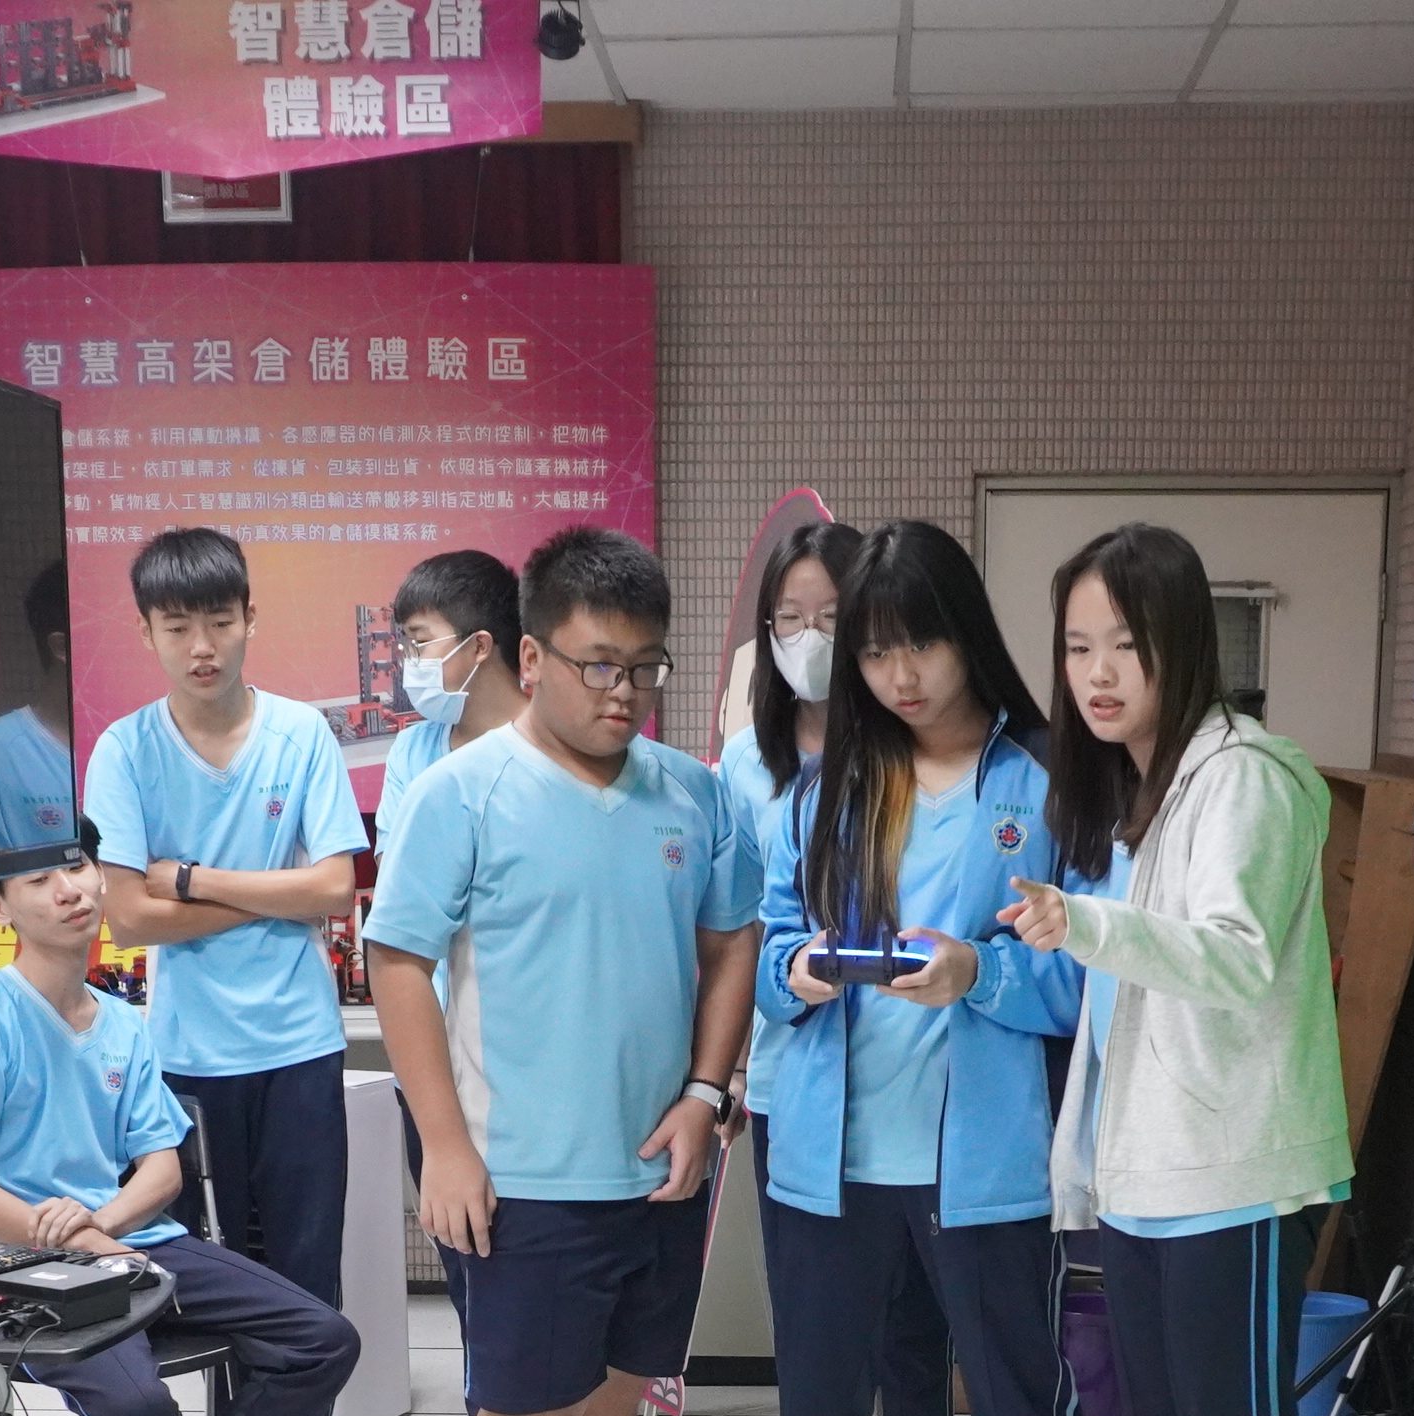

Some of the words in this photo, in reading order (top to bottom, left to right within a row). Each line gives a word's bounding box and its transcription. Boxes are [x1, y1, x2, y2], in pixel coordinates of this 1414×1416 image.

[228, 0, 483, 62] 智慧倉儲
[263, 74, 452, 138] 體驗區
[24, 336, 528, 387] 智慧高架倉儲體驗區
